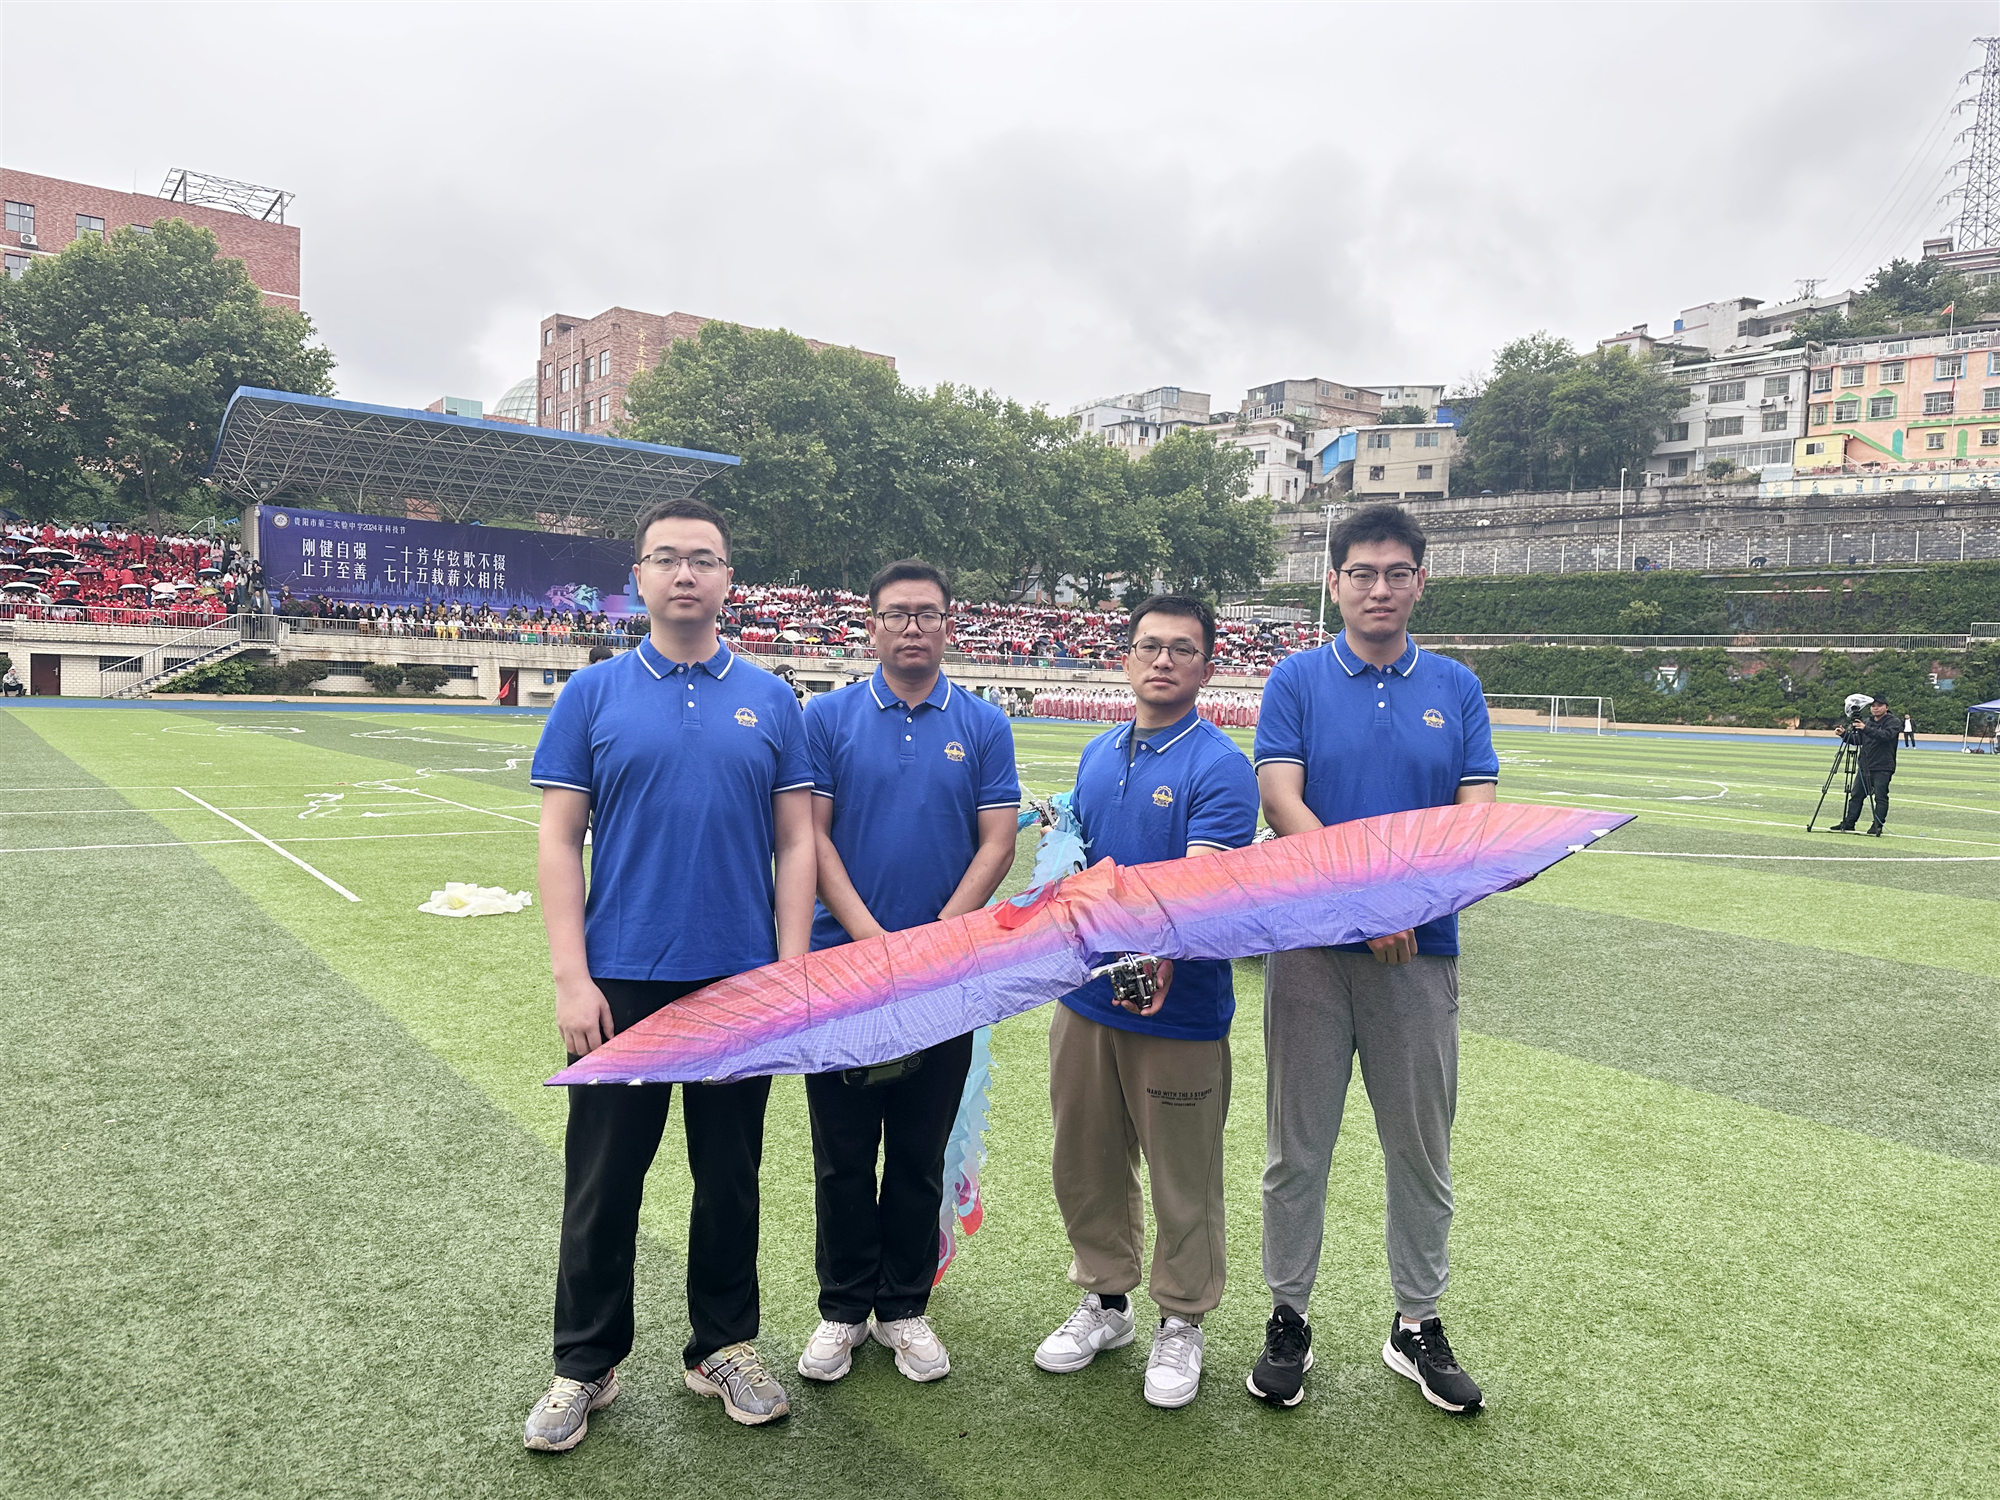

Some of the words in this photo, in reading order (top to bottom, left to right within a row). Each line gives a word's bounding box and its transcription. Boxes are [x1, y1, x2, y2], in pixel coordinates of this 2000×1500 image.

[294, 516, 406, 535] 贵阳市第三实验中学2024年科技节
[302, 538, 366, 560] 刚健自强
[383, 545, 506, 571] 二十芳华弦歌不辍
[301, 559, 367, 580] 止于至善
[383, 564, 506, 590] 七十五载薪火相传
[1163, 1090, 1177, 1098] WITH
